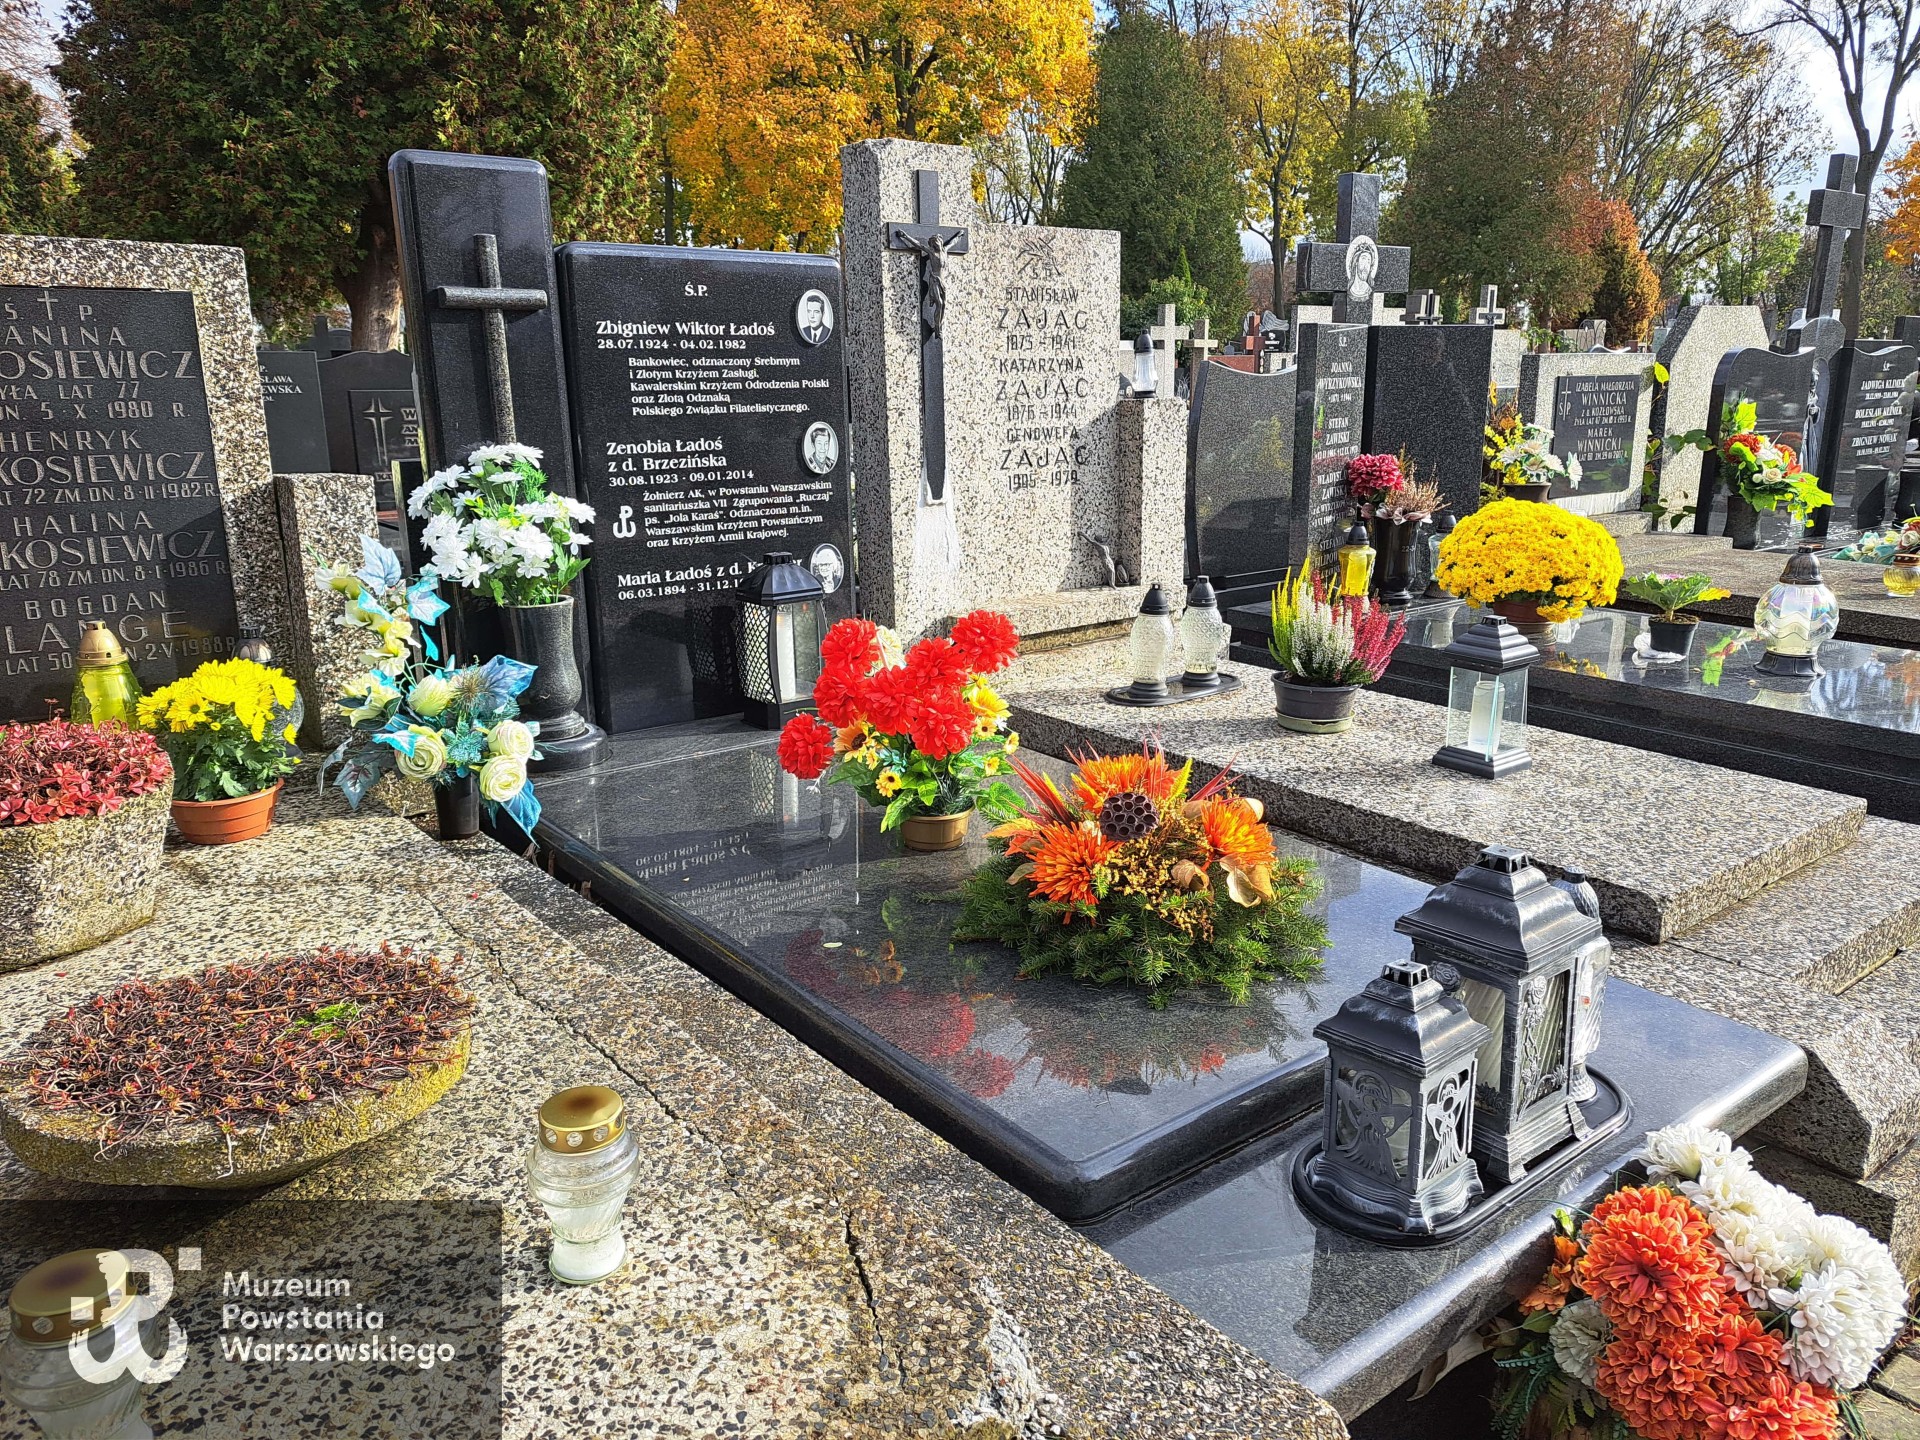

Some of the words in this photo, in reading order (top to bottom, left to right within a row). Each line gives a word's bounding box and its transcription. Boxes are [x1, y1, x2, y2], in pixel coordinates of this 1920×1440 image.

[684, 281, 709, 297] Ś.P.
[1005, 286, 1079, 303] STANISŁAW
[595, 320, 671, 337] Zbigniew
[674, 321, 726, 336] Wiktor
[729, 321, 775, 336] Ładoś
[597, 339, 669, 349] 28.07.1924
[680, 339, 746, 349] 04.02.1982
[628, 357, 689, 368] Bankowiec,
[692, 357, 752, 368] odznaczony
[754, 356, 801, 368] Srebrnym
[999, 358, 1084, 374] KATARZYNA
[636, 369, 673, 380] Złotym
[675, 369, 720, 381] Krzyżem
[58, 384, 94, 400] LAT
[116, 381, 140, 399] 77
[630, 380, 697, 391] Kawalerskim
[700, 380, 743, 391] Krzyżem
[745, 379, 800, 390] Odrodzenia
[802, 379, 830, 388] Polski
[1576, 382, 1599, 392] IZABELA
[631, 395, 655, 403] oraz
[658, 393, 684, 405] Złotą
[686, 392, 731, 404] Odznaką
[1581, 391, 1627, 406] WINNICKA
[107, 400, 153, 419] 1980
[632, 406, 683, 417] Polskiego
[685, 404, 727, 416] Związku
[729, 402, 810, 415] Filatelistycznego.
[1328, 416, 1349, 429] STEFAN
[0, 429, 142, 453] HENRYK
[1006, 426, 1080, 442] GENOWEFA
[1587, 427, 1613, 438] MAREK
[606, 439, 671, 456] Zenobia
[676, 436, 723, 452] Ładoś
[1577, 437, 1622, 453] WINNICKI
[608, 462, 617, 473] z
[622, 458, 637, 472] d.
[642, 454, 727, 471] Brzezińska
[609, 473, 679, 487] 30.08.1923
[689, 469, 754, 483] 09.01.2014
[22, 487, 48, 505] 72
[643, 489, 685, 502] Żołnierz
[688, 489, 705, 499] AK,
[719, 484, 769, 497] Powstaniu
[771, 480, 832, 493] Warszawskim
[643, 500, 711, 513] sanitariuszka
[713, 498, 727, 508] VII
[732, 493, 793, 507] Zgrupowania
[12, 510, 154, 537] HALINA
[644, 516, 660, 527] ps.
[729, 506, 788, 518] Odznaczona
[789, 503, 812, 514] m.in.
[645, 522, 715, 537] Warszawskim
[717, 518, 759, 532] Krzyżem
[760, 513, 823, 528] Powstańczym
[646, 539, 669, 549] oraz
[672, 534, 716, 548] Krzyżem
[718, 532, 744, 543] Armii
[746, 527, 790, 541] Krajowej.
[0, 530, 220, 571] KOSIEWICZ
[0, 573, 31, 591] LAT
[37, 570, 61, 589] 78
[617, 571, 661, 588] Maria
[665, 564, 712, 581] Ładoś
[716, 566, 725, 577] z
[728, 561, 743, 576] d.
[618, 585, 687, 601] 06.03.1894
[23, 590, 167, 620] BOGDAN
[5, 656, 43, 677] LAT
[48, 651, 73, 672] 50
